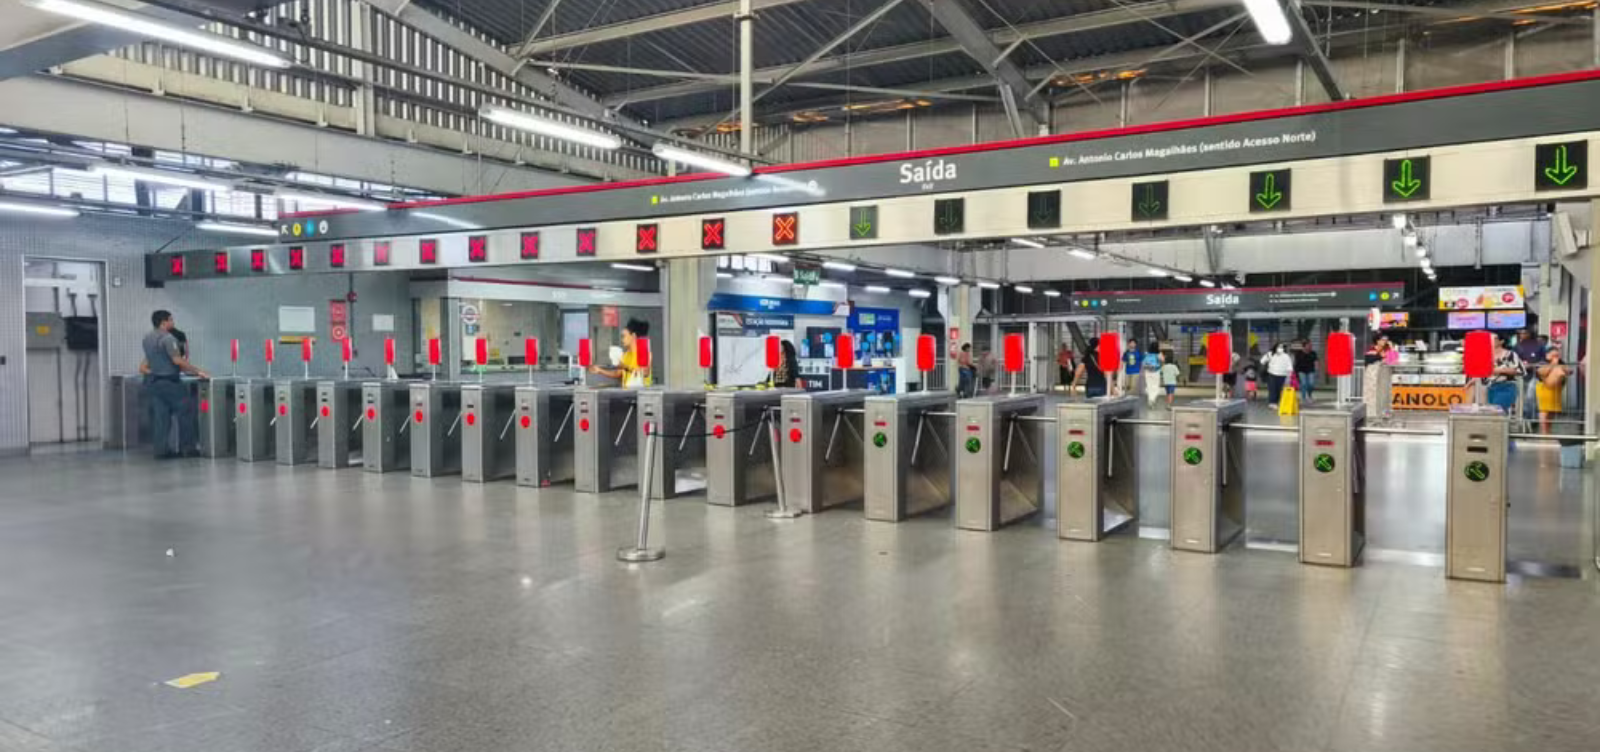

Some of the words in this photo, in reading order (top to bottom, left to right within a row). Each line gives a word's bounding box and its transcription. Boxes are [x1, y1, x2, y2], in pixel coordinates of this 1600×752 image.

[1063, 157, 1076, 166] Av.
[1078, 153, 1113, 164] Antonio
[1114, 150, 1143, 161] Carlos
[1145, 144, 1198, 158] Magalhães
[1199, 139, 1241, 153] (sentido
[1242, 135, 1281, 148] Acesso
[1282, 130, 1316, 144] Norte)
[900, 160, 957, 183] Saída
[1206, 293, 1240, 305] Saída
[808, 380, 823, 388] TIM
